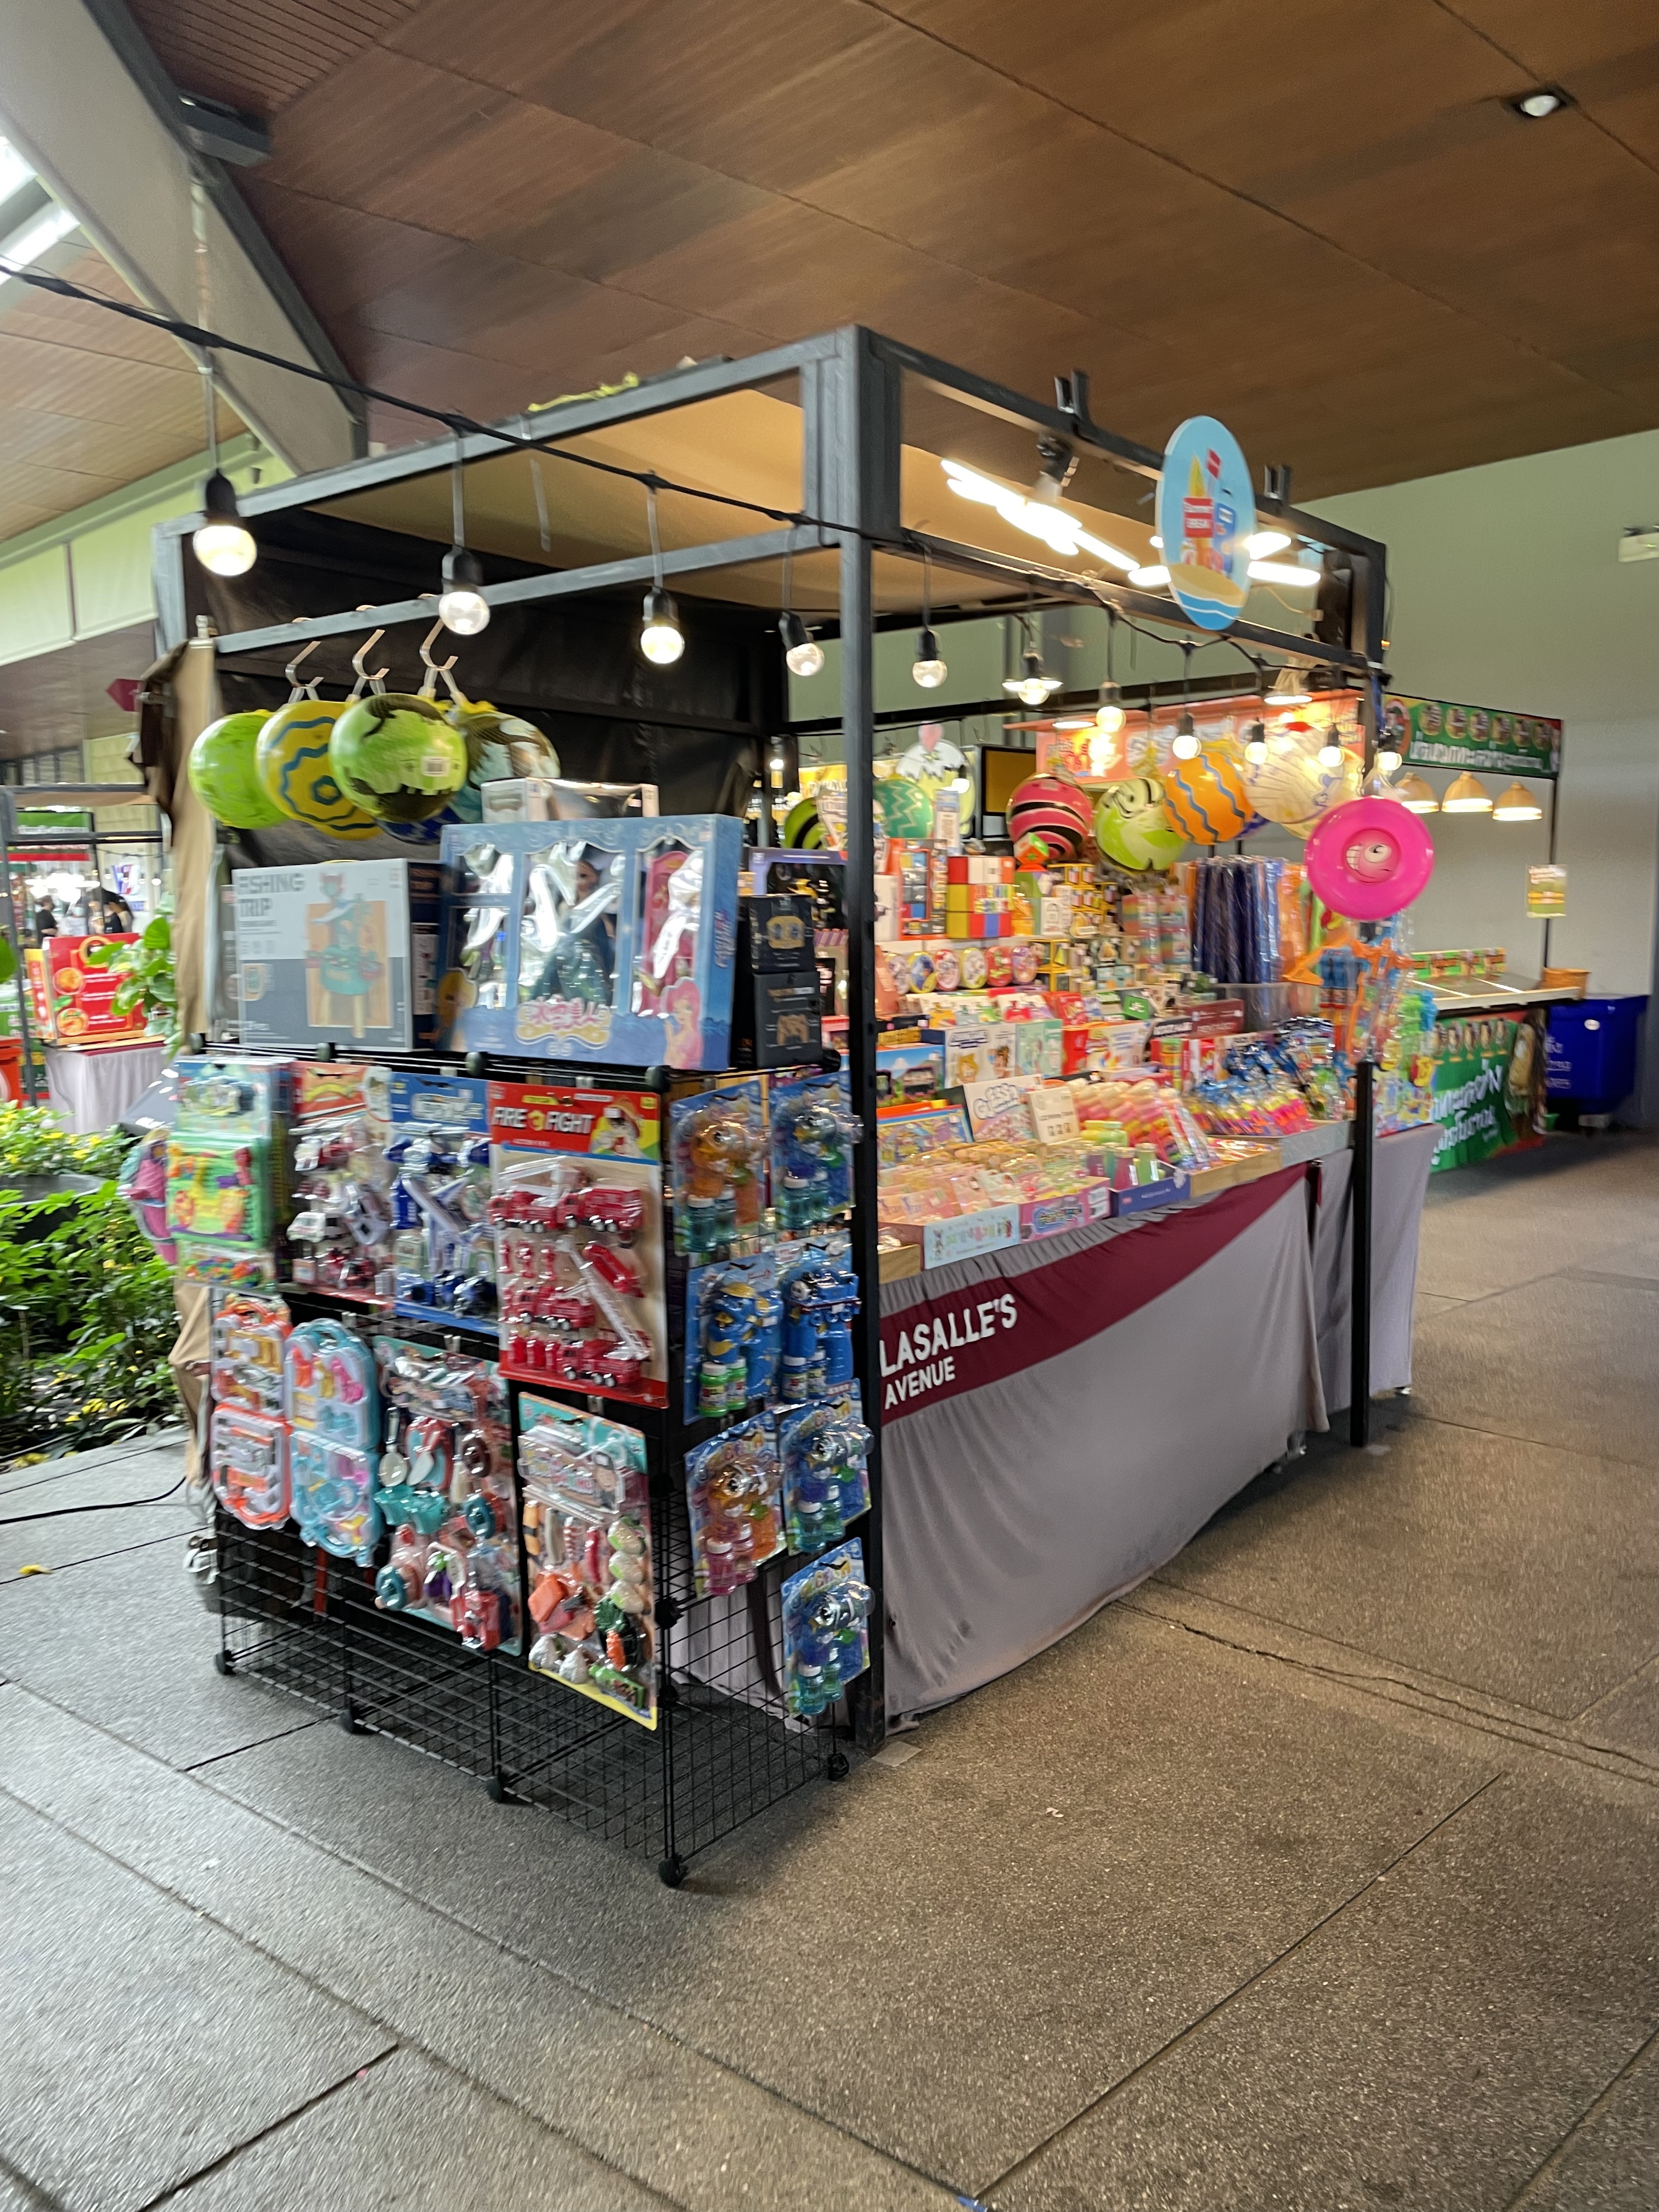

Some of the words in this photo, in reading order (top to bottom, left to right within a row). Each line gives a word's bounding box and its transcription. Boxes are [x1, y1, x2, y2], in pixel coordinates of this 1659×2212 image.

[492, 1106, 528, 1128] FIRE
[879, 1294, 1018, 1378] LASALLE'S
[885, 1356, 956, 1410] AVENUE
